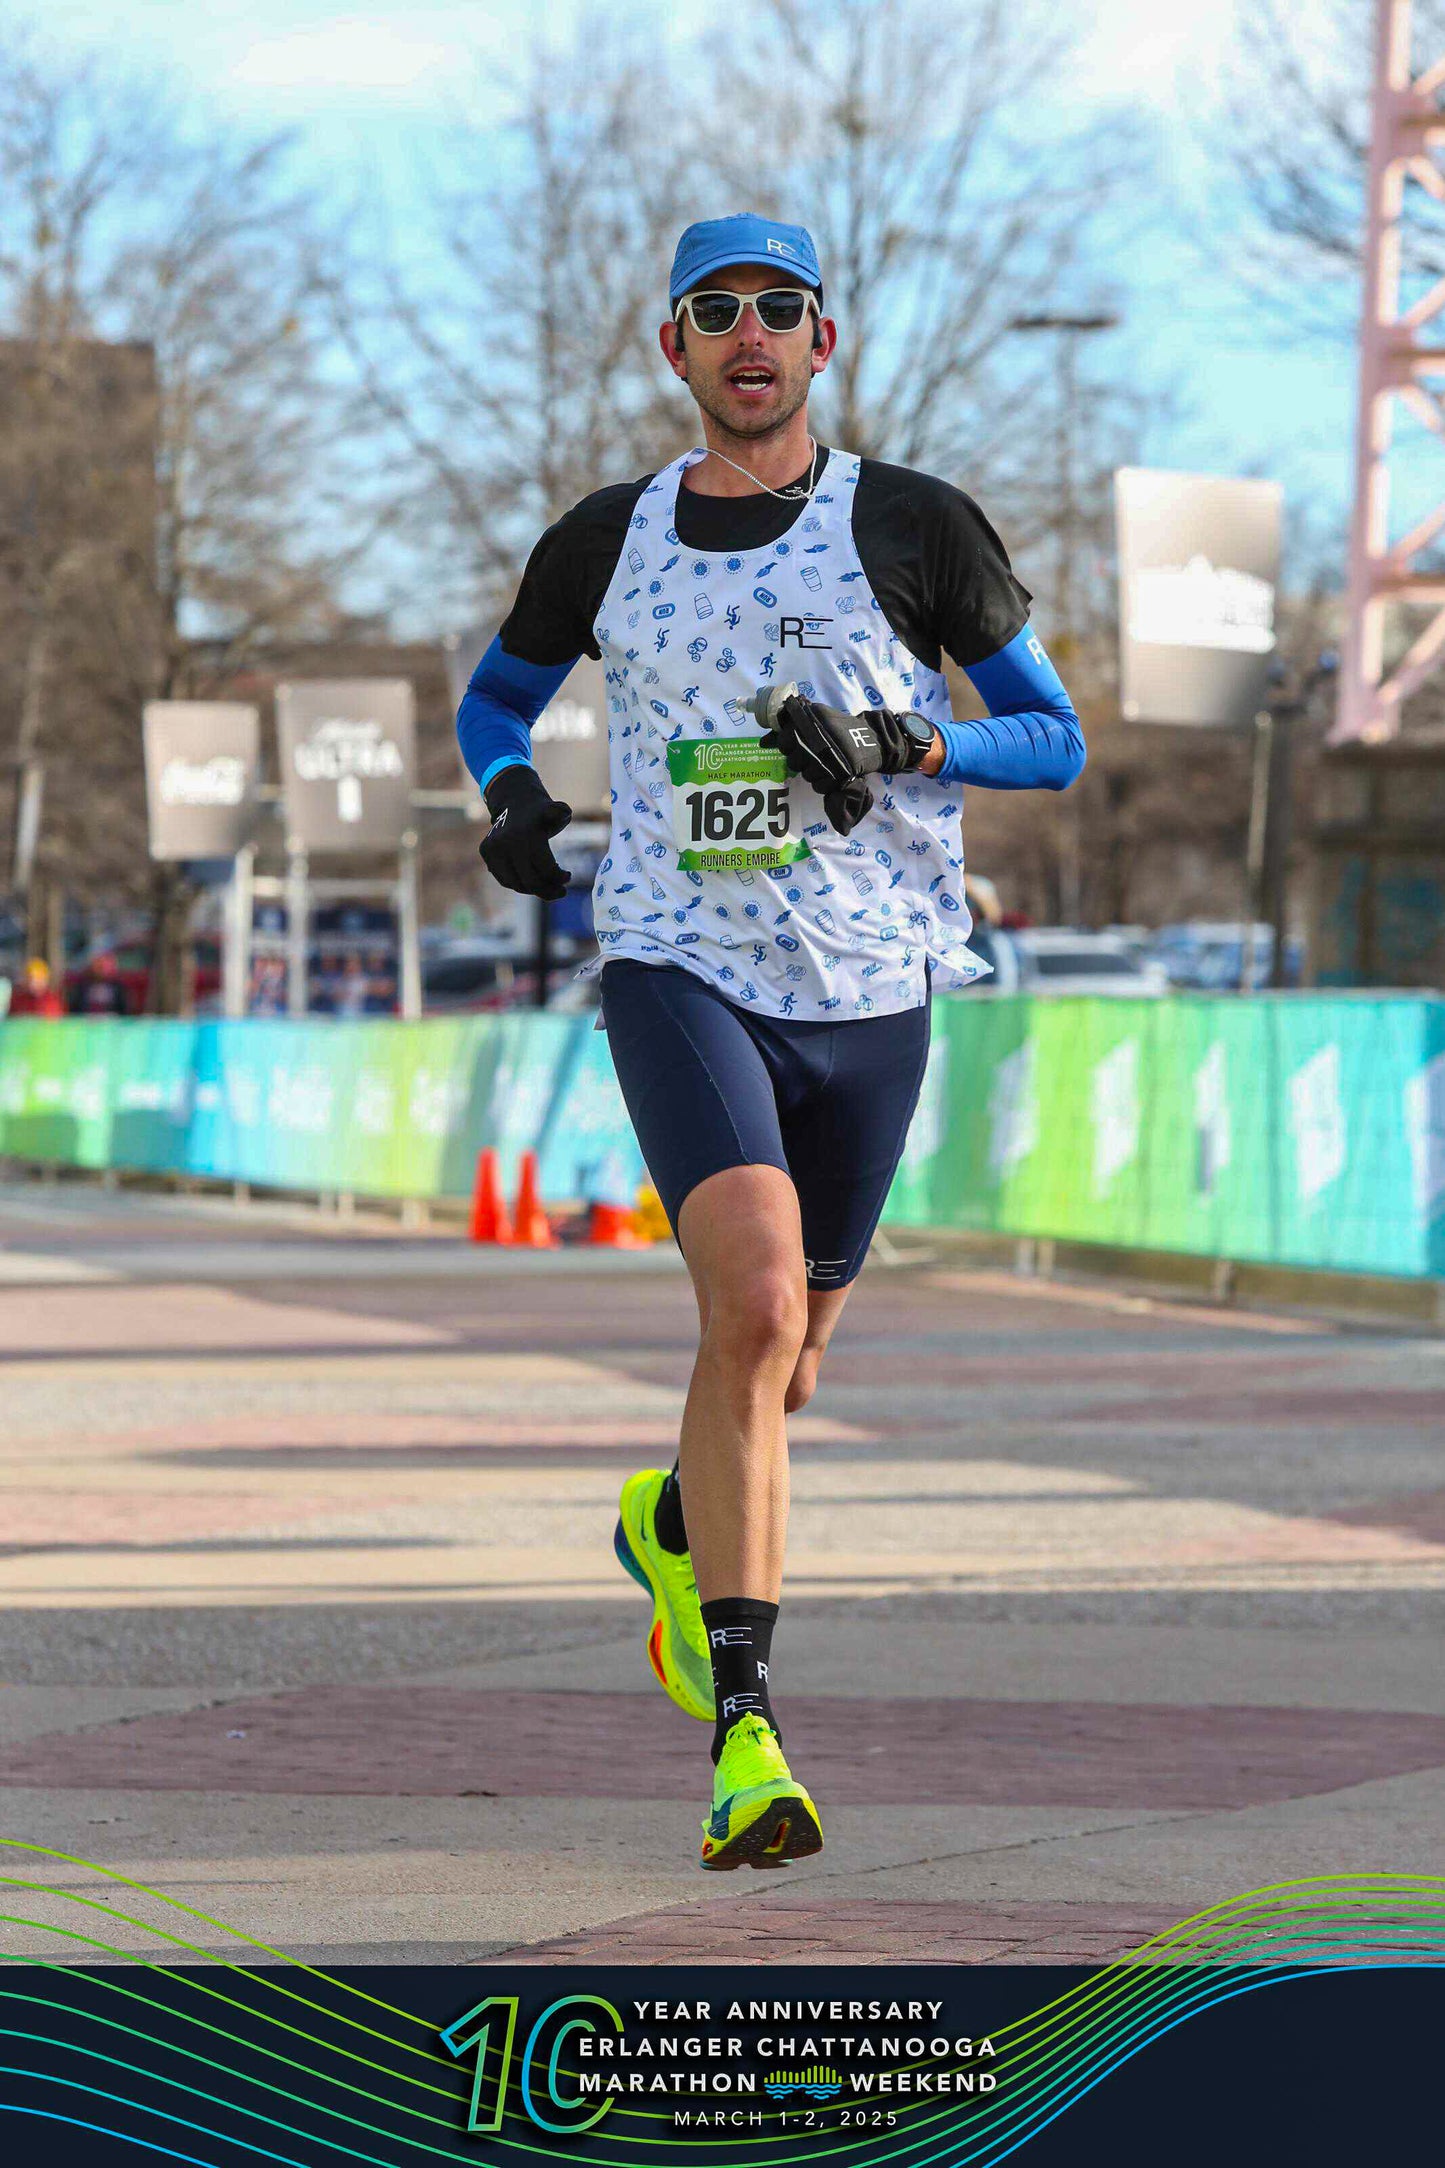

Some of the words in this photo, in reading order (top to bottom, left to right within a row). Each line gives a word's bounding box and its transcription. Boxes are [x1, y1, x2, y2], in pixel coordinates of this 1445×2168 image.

[708, 772, 728, 780] HALF
[729, 771, 771, 779] MARATHON
[686, 787, 790, 842] 1625
[700, 854, 743, 867] RUNNERS
[746, 851, 781, 866] EMPIRE
